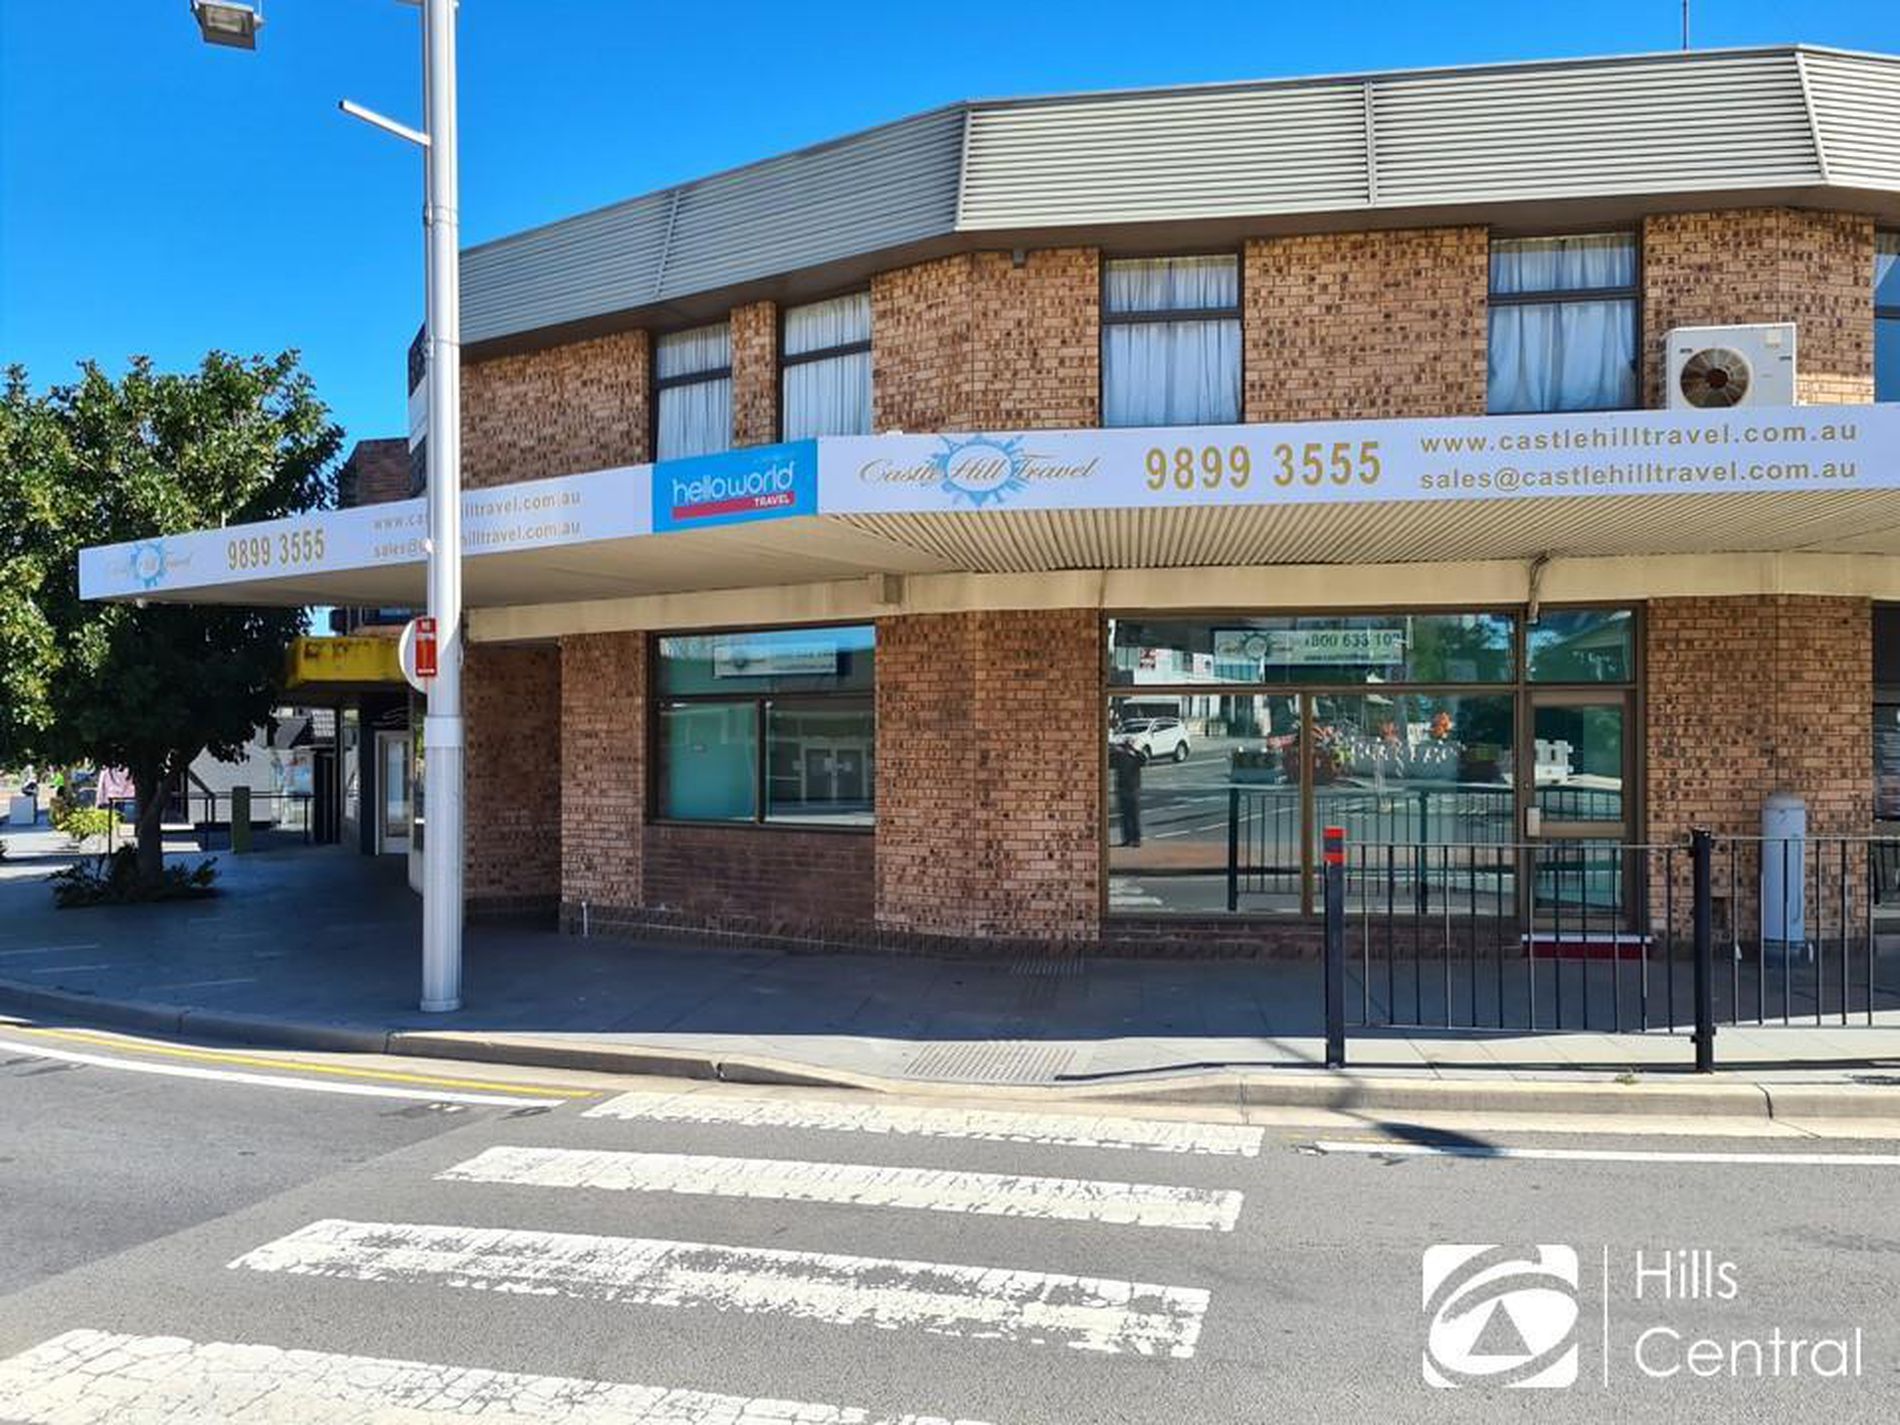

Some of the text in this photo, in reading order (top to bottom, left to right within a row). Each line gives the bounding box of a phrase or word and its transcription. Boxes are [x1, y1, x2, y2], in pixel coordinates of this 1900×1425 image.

[1419, 422, 1858, 454] www.castlehilltravel.com.au
[672, 460, 795, 504] helloworld
[950, 455, 1006, 481] Hill
[1013, 453, 1100, 480] Travel
[1145, 441, 1382, 491] 9899 3555
[1419, 458, 1858, 493] sales@castlehilltravel.com.au
[754, 492, 791, 508] TRAVEL
[227, 537, 272, 571] 9899
[278, 528, 326, 565] 3555
